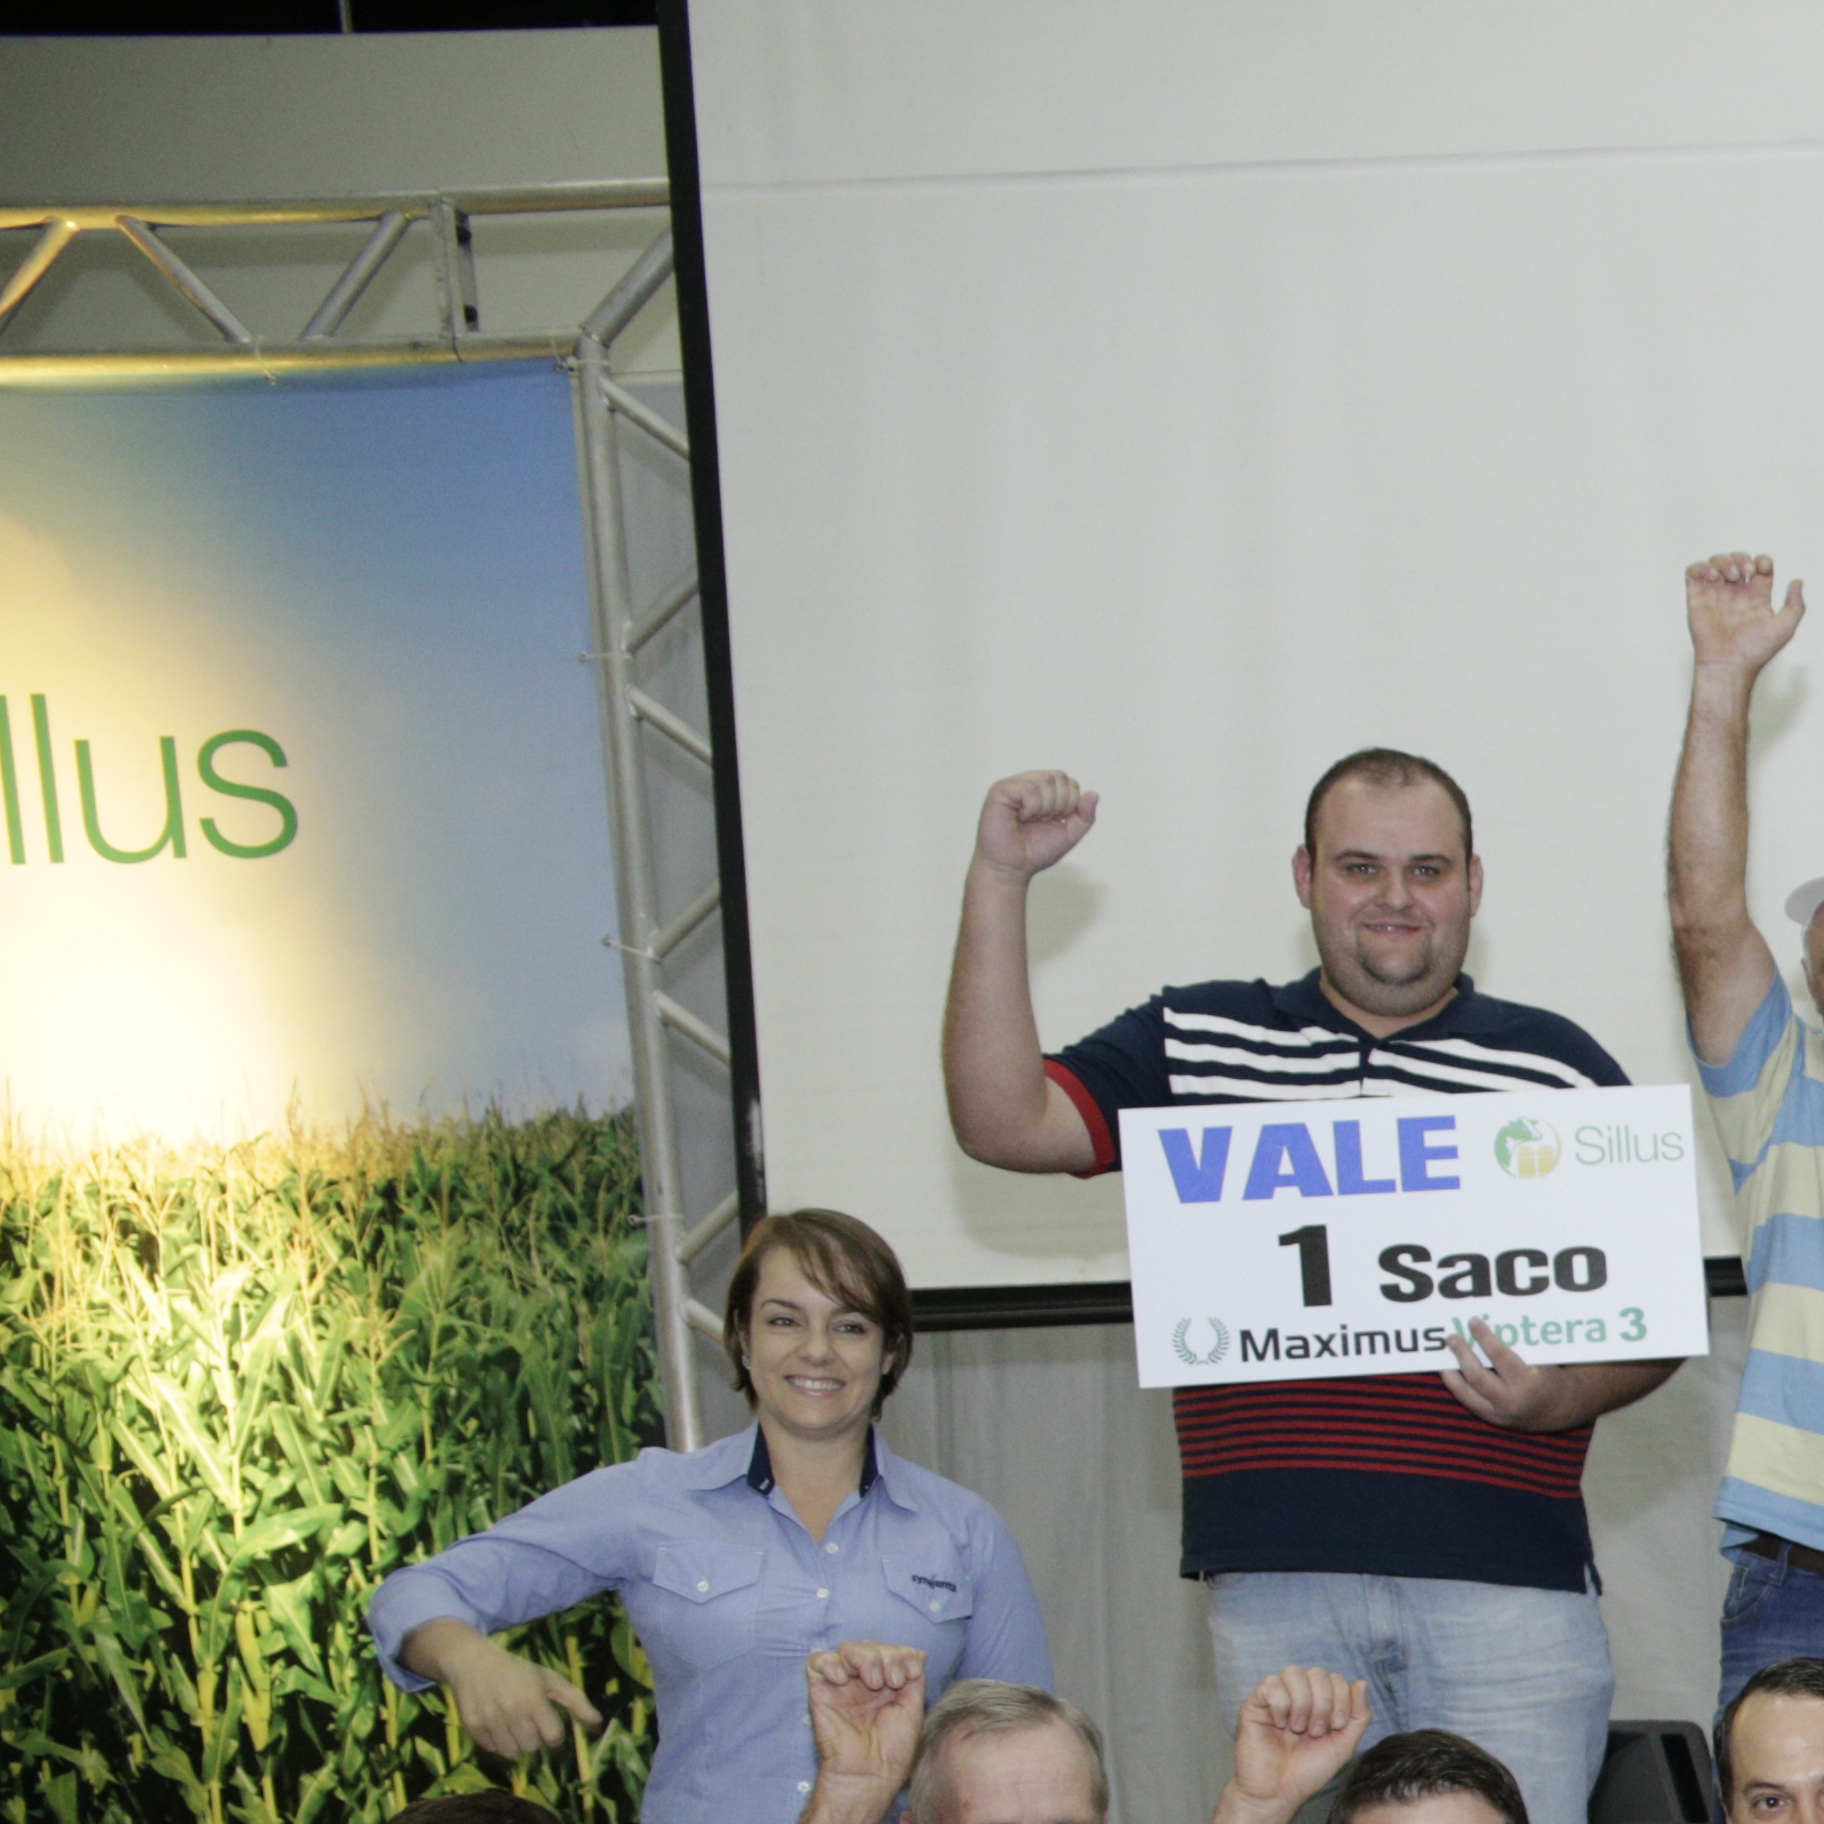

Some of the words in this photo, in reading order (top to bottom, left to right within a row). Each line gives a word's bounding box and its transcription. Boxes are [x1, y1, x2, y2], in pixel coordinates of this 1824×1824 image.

[0, 693, 298, 865] llus
[1157, 1115, 1460, 1204] VALE
[1575, 1124, 1684, 1167] Sillus
[1278, 1224, 1332, 1308] 1
[1378, 1244, 1608, 1303] Saco
[1239, 1324, 1447, 1363] Maximus
[1451, 1313, 1607, 1349] Vptera
[1619, 1307, 1647, 1342] 3
